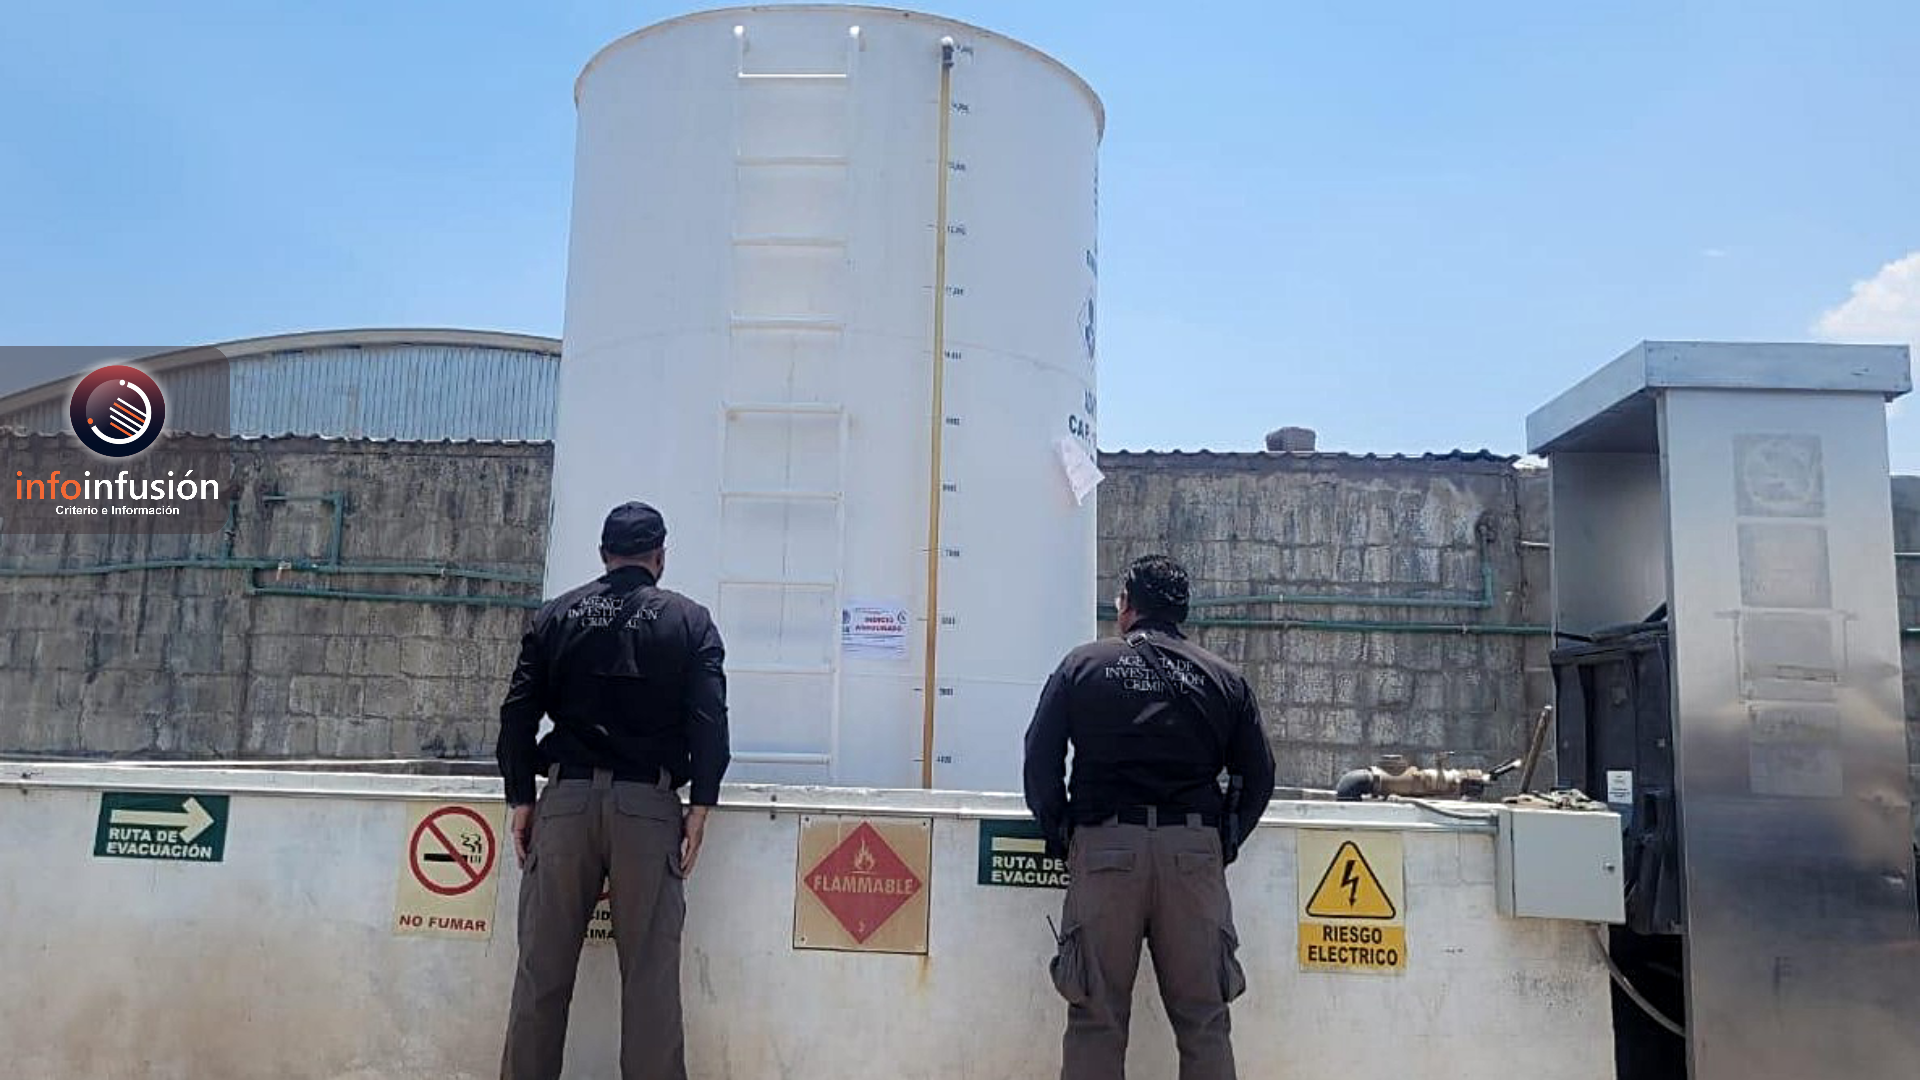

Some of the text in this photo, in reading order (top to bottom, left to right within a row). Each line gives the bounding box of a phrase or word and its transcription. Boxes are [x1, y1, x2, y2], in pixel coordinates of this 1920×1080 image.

[109, 827, 178, 844] RUTA DE
[106, 841, 213, 860] EVACUACIÓN
[992, 856, 1065, 871] RUTA DE
[813, 875, 914, 895] FLAMMABLE
[991, 870, 1070, 885] EVACUAC
[399, 915, 487, 932] NO FUMAR
[1323, 924, 1383, 944] RIESGO
[1308, 945, 1398, 966] ELECTRICO
